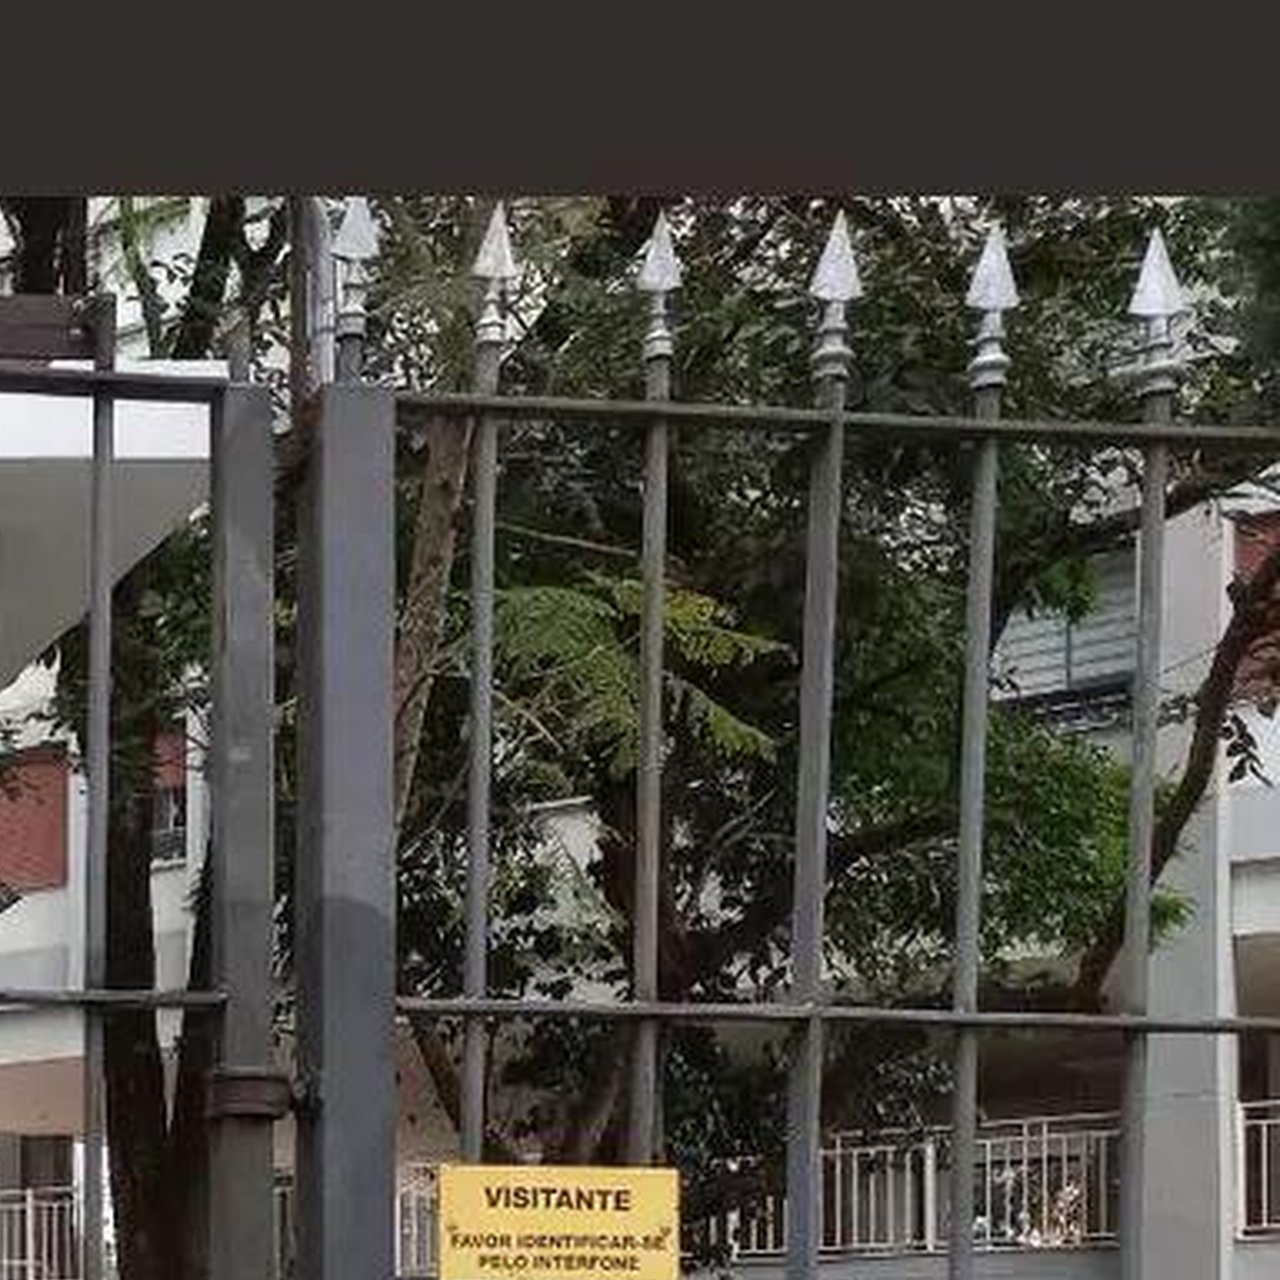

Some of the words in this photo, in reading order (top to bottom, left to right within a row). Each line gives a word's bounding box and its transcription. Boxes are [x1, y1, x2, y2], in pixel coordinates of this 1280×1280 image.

[484, 1186, 632, 1211] VISITANTE
[450, 1232, 513, 1249] FAVOR
[517, 1233, 666, 1251] IDENTIFICAR-SE
[478, 1254, 529, 1271] PELO
[532, 1254, 640, 1272] INTERFONE
